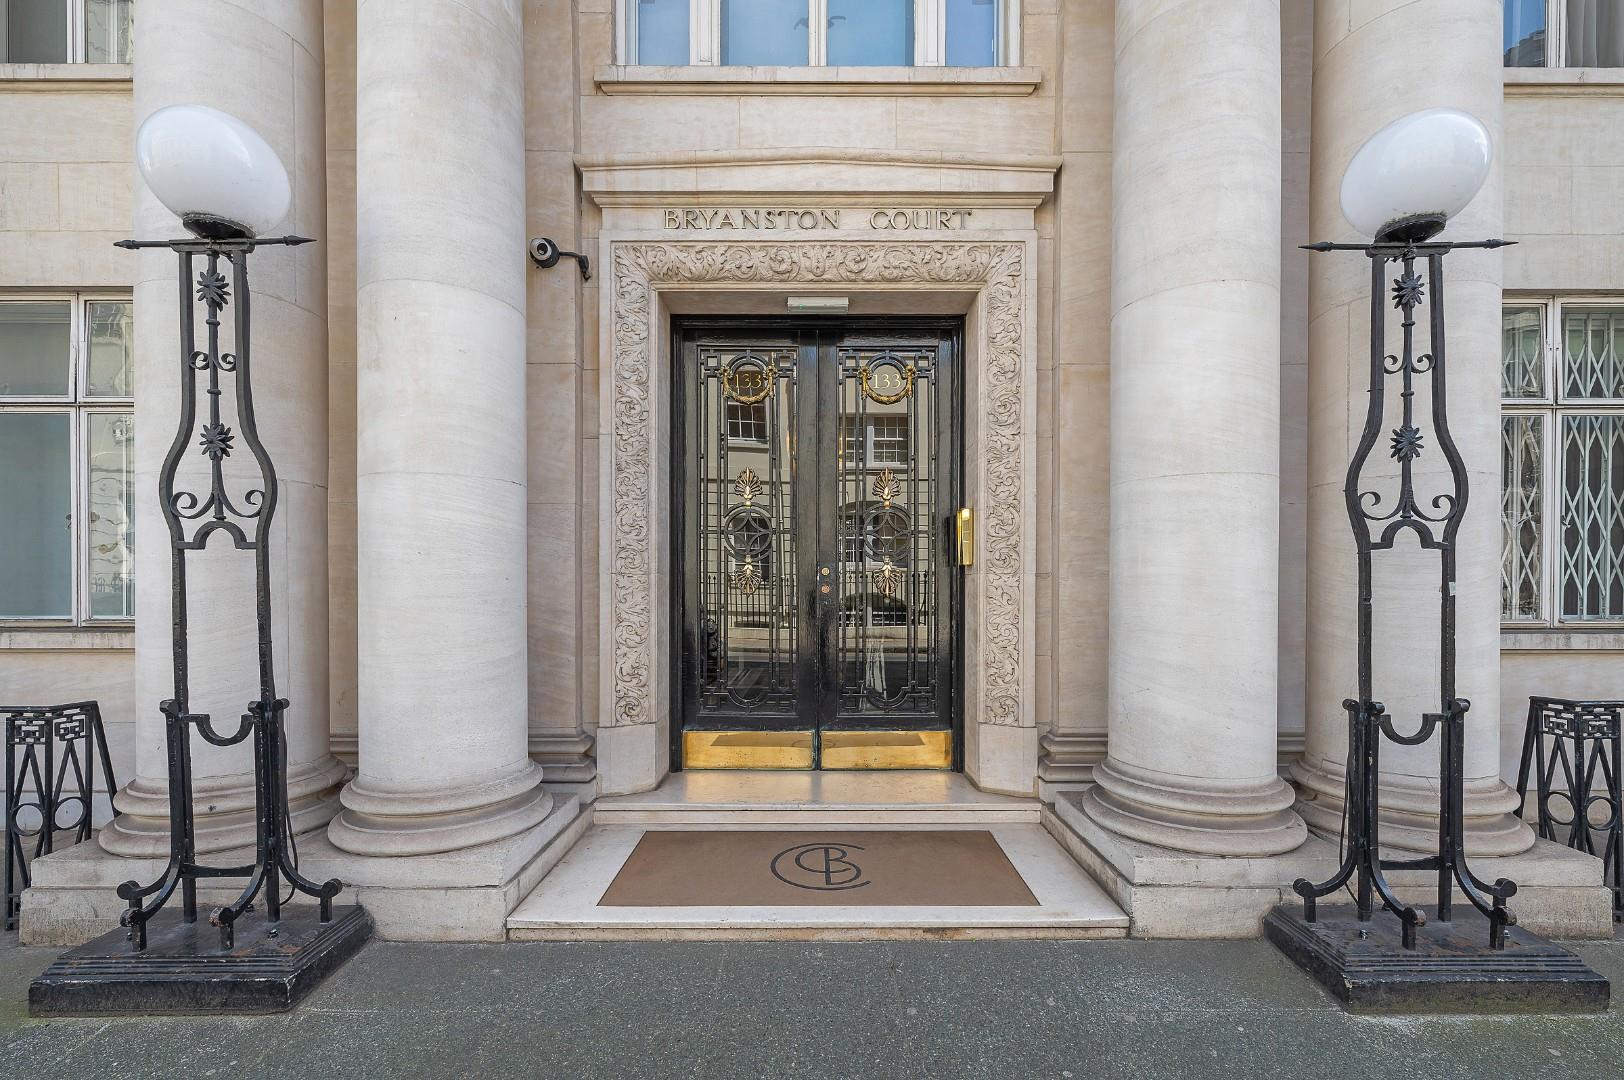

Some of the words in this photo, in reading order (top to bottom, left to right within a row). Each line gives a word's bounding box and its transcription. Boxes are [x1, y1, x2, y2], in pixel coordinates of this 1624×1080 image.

[663, 209, 840, 230] BRYANSTON
[869, 209, 973, 230] COURT
[735, 373, 762, 389] 133
[872, 373, 901, 389] 133
